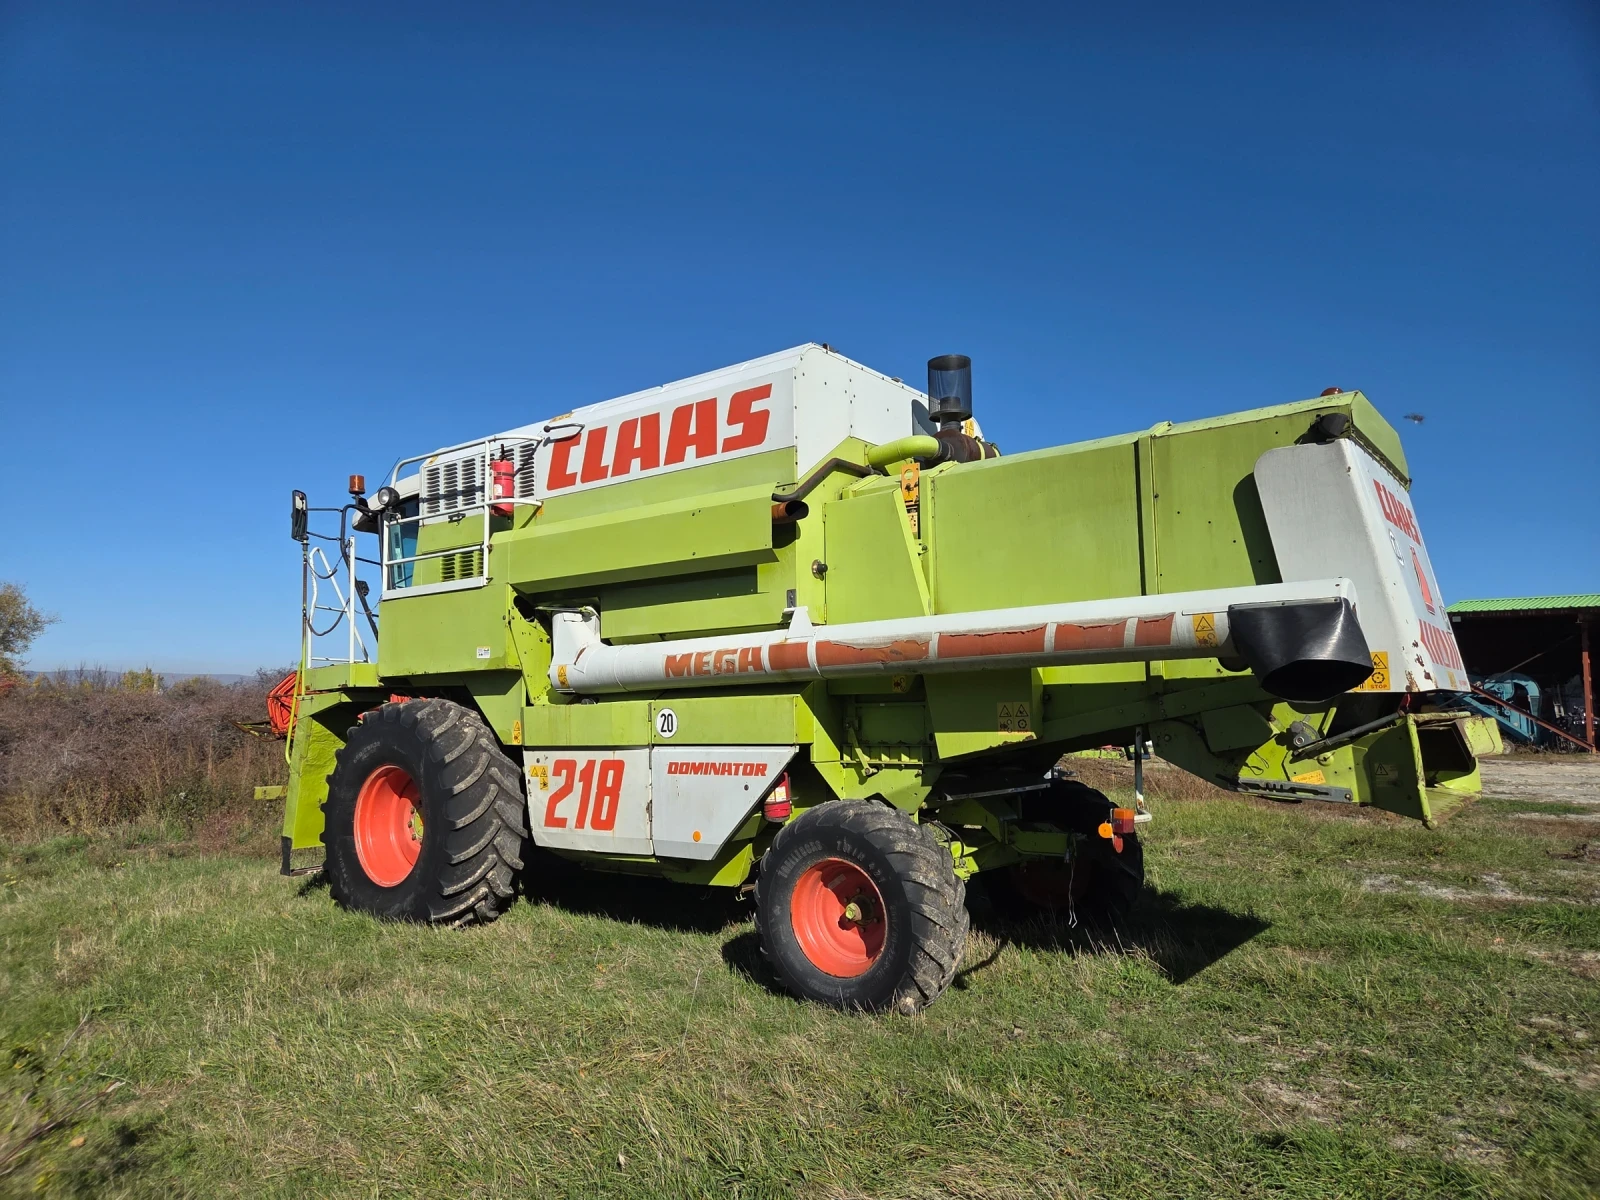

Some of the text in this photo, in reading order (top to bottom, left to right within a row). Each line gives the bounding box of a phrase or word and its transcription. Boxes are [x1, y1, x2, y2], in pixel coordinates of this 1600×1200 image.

[546, 383, 772, 491] CLAAS
[664, 646, 763, 678] MEGA
[660, 713, 673, 733] 20
[667, 761, 767, 777] DOMINATOR
[544, 759, 625, 831] 218
